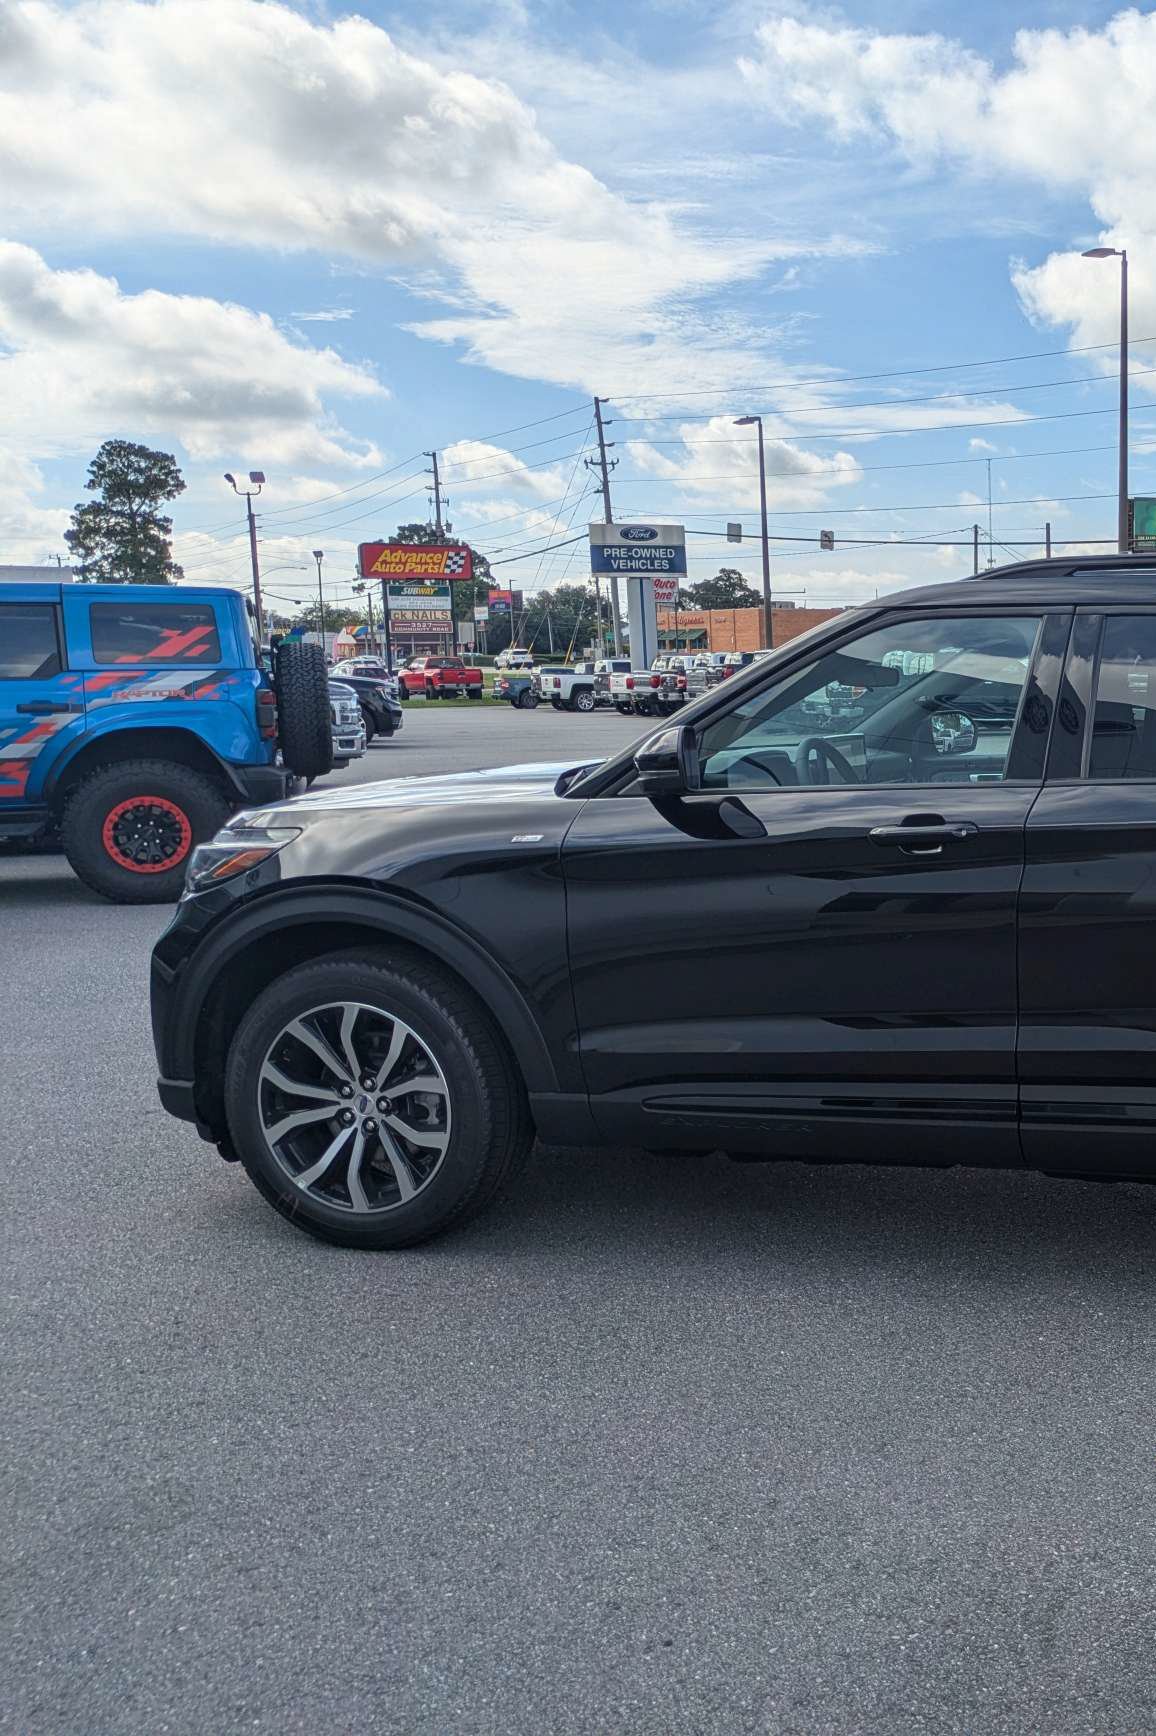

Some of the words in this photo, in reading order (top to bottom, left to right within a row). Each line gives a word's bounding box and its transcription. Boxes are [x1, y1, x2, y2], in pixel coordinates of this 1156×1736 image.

[628, 528, 651, 539] Ford
[378, 549, 441, 562] Advance
[604, 548, 675, 558] PRE-OWNED
[371, 562, 403, 572] Auto
[404, 562, 439, 572] Parts
[611, 560, 670, 570] VEHICLES
[401, 587, 437, 595] SUBWAY
[411, 610, 449, 620] NAILS
